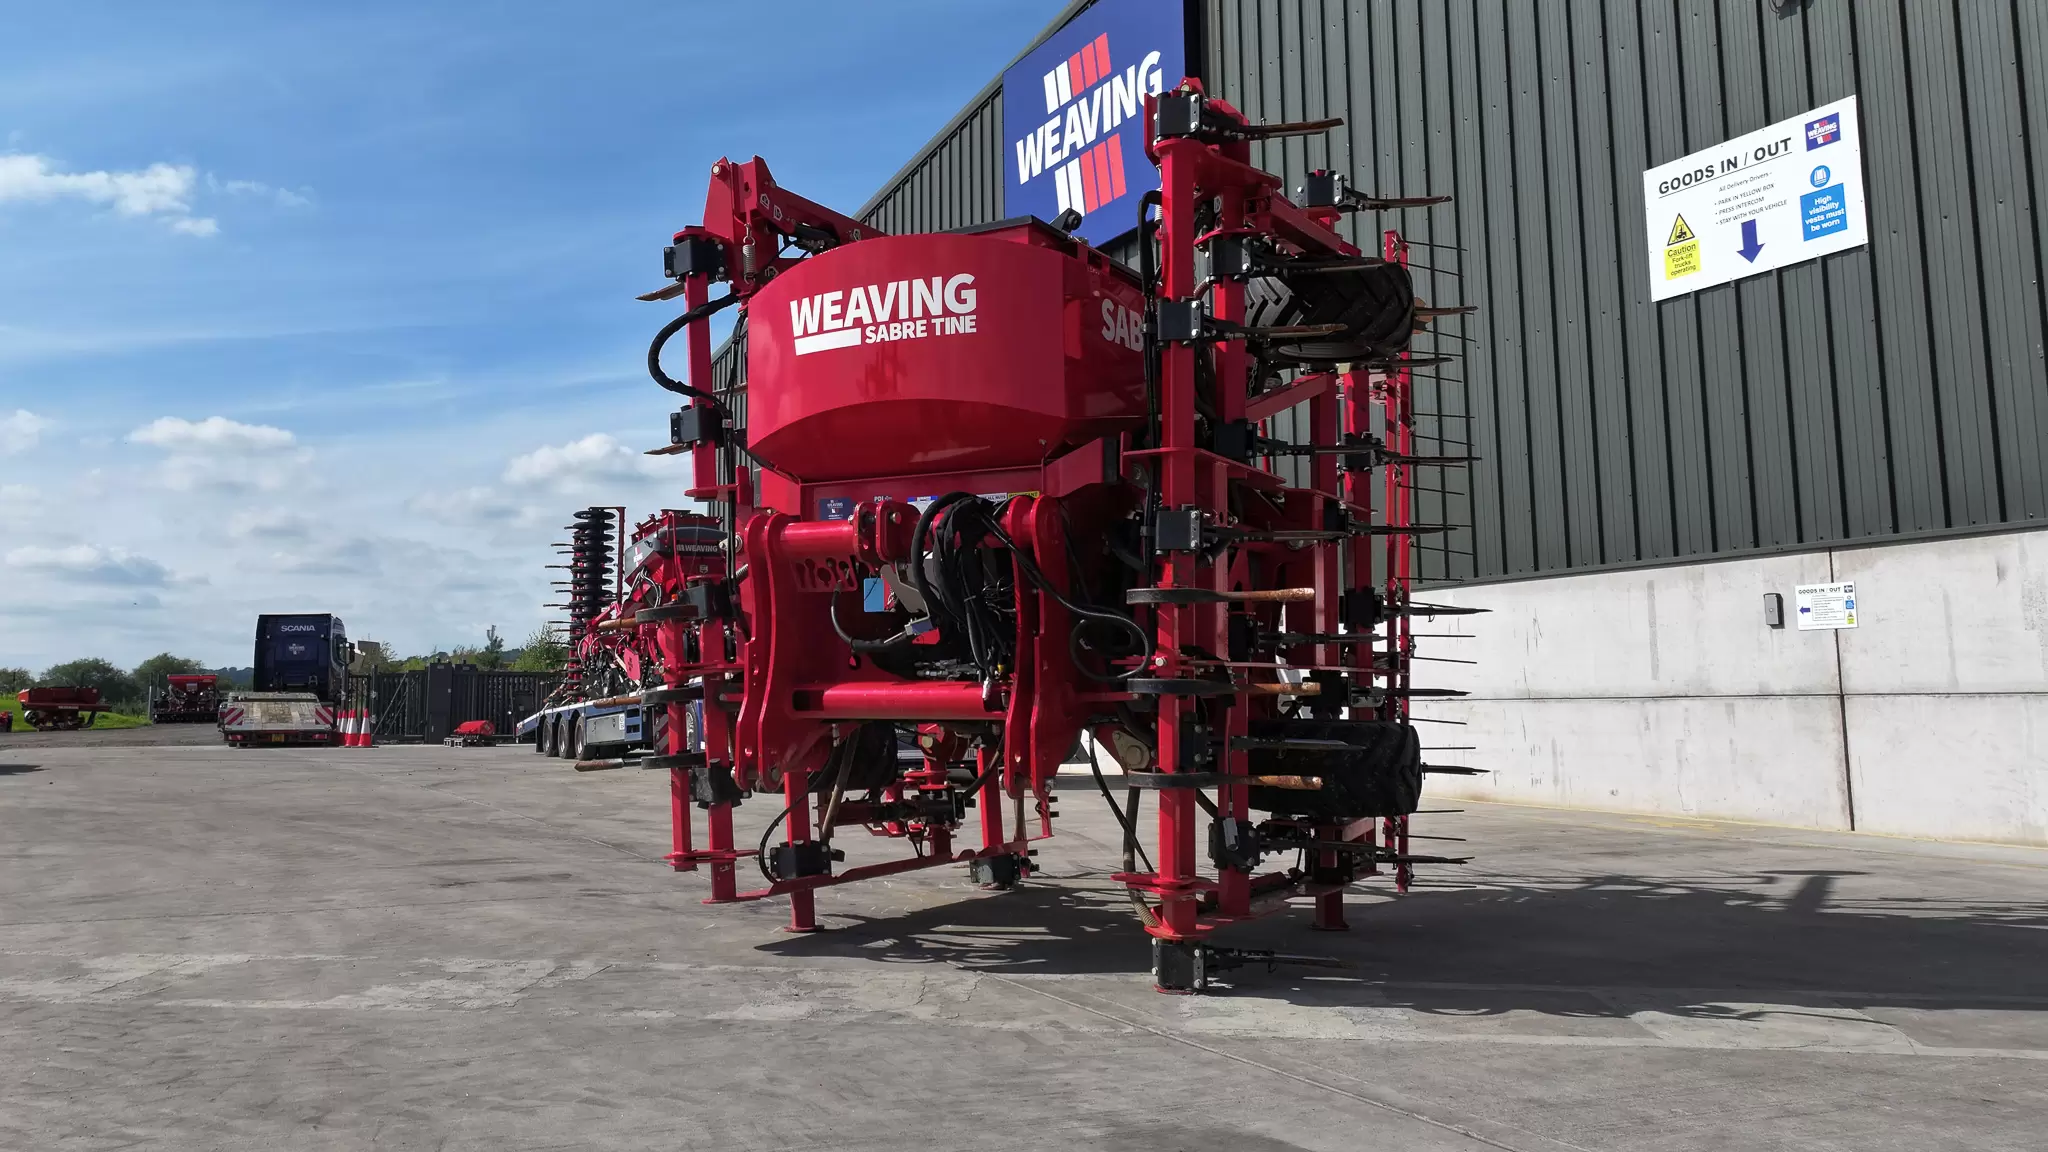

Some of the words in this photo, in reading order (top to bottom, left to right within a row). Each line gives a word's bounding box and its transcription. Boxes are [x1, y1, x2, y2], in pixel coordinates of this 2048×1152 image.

[1016, 50, 1162, 185] WEAVING
[1808, 122, 1837, 138] WEAVING
[1658, 165, 1715, 195] GOODS
[1720, 156, 1738, 173] IN
[1744, 152, 1748, 166] /
[1754, 137, 1791, 161] OUT
[1726, 179, 1748, 190] Delivery
[1749, 172, 1769, 182] Drivers
[1718, 196, 1732, 205] PARK
[1740, 187, 1762, 198] YELLOW
[1763, 182, 1775, 191] BOX
[1814, 195, 1832, 206] High
[1718, 205, 1735, 215] PRESS
[1735, 196, 1765, 209] INTERCOM
[1719, 216, 1732, 225] STAY
[1732, 212, 1747, 221] WITH
[1748, 206, 1764, 216] YOUR
[1764, 199, 1788, 211] VEHICLE
[1808, 202, 1839, 215] visibility
[1805, 214, 1825, 225] vests
[1825, 208, 1845, 219] must
[1810, 222, 1821, 232] be
[1821, 219, 1840, 229] worn
[1667, 244, 1697, 257] Caution
[1670, 264, 1697, 276] operating
[1674, 260, 1692, 269] trucks
[789, 273, 977, 339] WEAVING
[865, 320, 927, 345] SABRE
[931, 315, 977, 337] TINE
